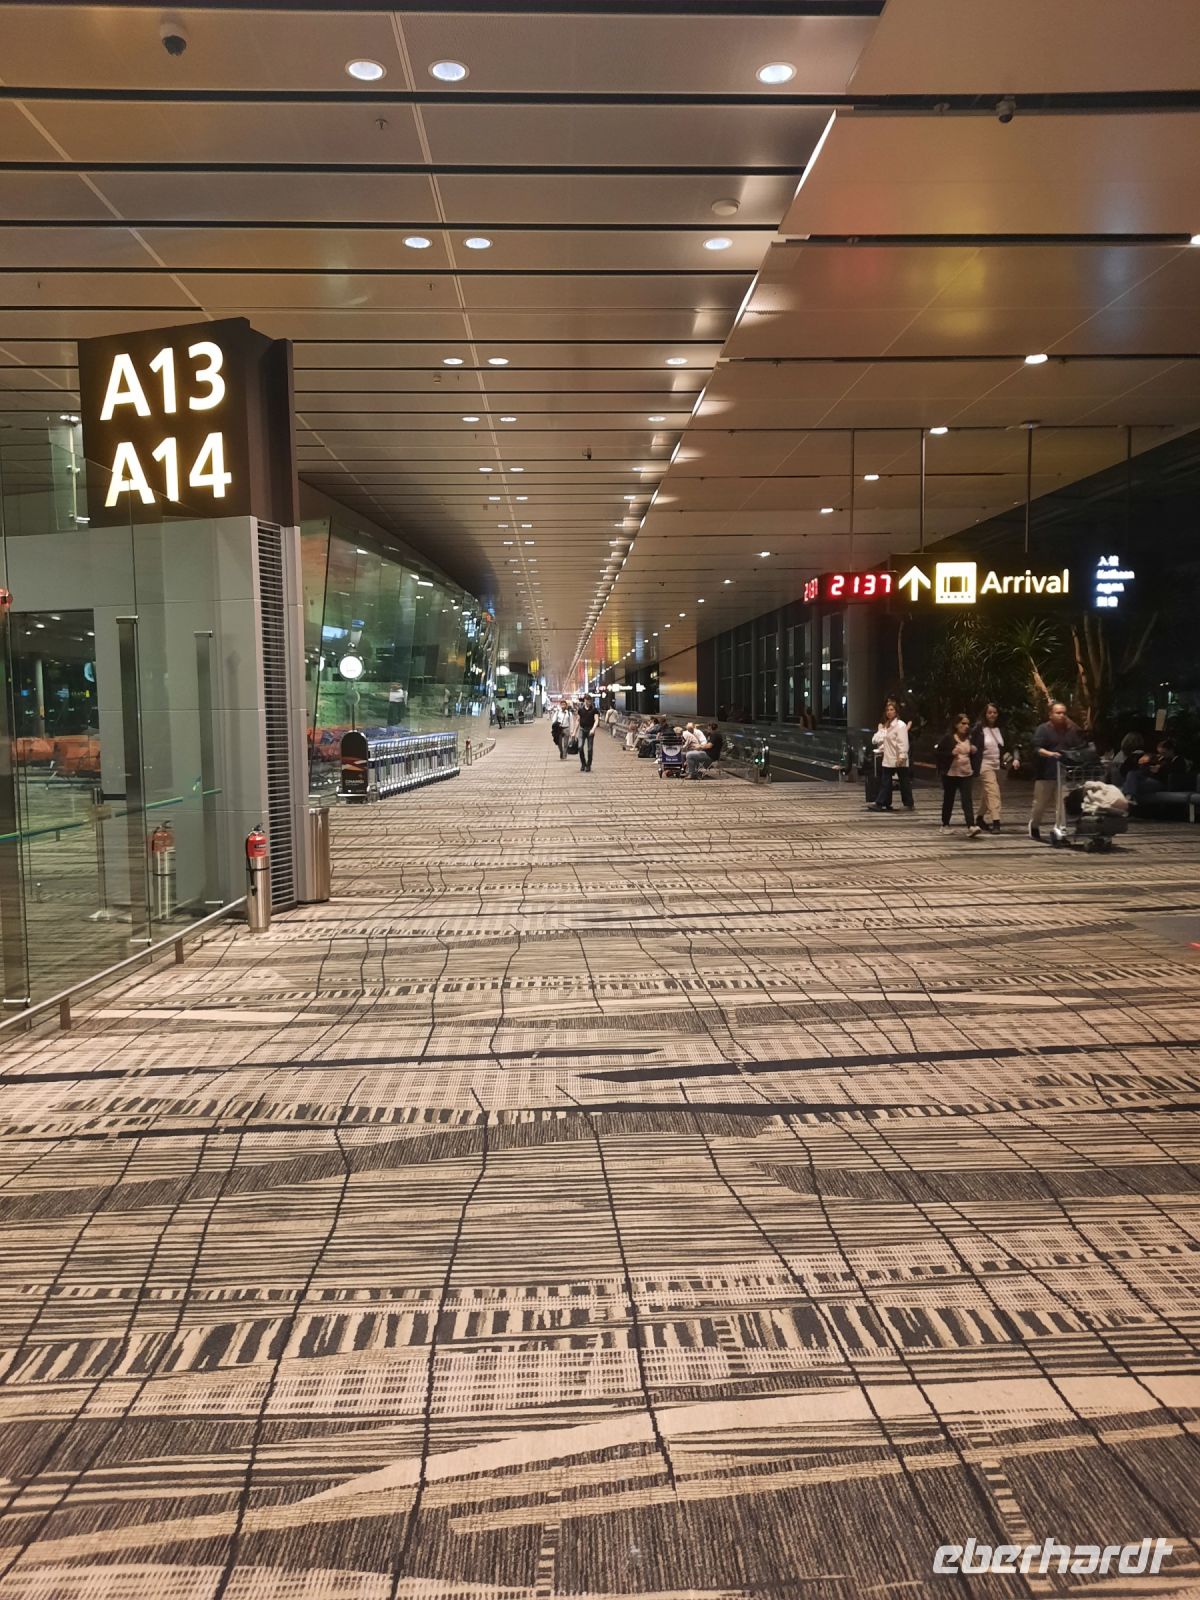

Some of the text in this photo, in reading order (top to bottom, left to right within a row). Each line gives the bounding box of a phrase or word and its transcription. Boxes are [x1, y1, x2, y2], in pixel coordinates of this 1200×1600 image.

[100, 341, 226, 421] A13
[104, 432, 232, 508] A14
[831, 574, 892, 596] 2137
[980, 568, 1070, 595] Arrival
